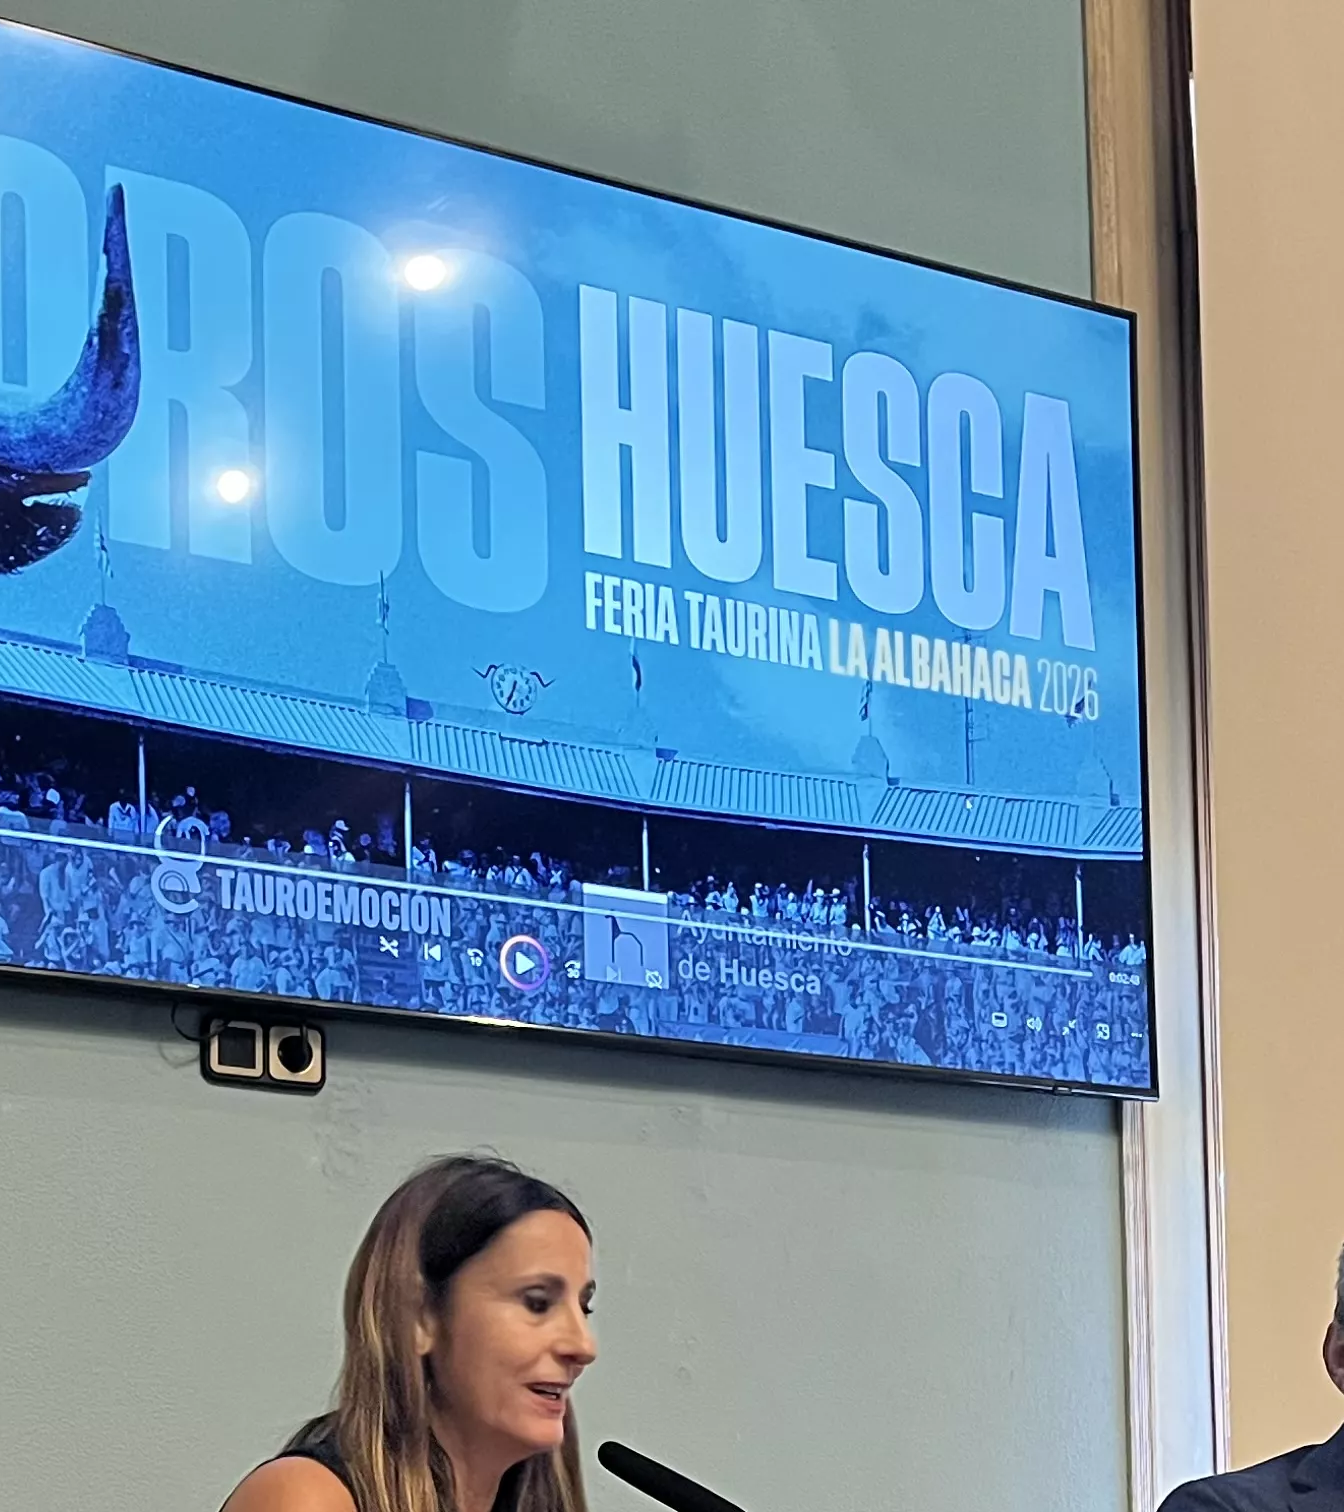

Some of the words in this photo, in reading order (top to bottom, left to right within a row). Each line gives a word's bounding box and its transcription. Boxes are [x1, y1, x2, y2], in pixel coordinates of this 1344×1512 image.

[578, 283, 1096, 652] HUESCA
[585, 571, 679, 647] FERIA
[683, 590, 823, 671] TAURINA
[829, 618, 869, 680] LA
[872, 627, 1033, 710] ALBAHACA
[1036, 659, 1099, 722] 2026
[216, 867, 452, 938] TAUROEMOCIÓN
[677, 909, 853, 957] Ayuntamiento
[678, 955, 711, 981] de
[719, 957, 822, 995] Huesca
